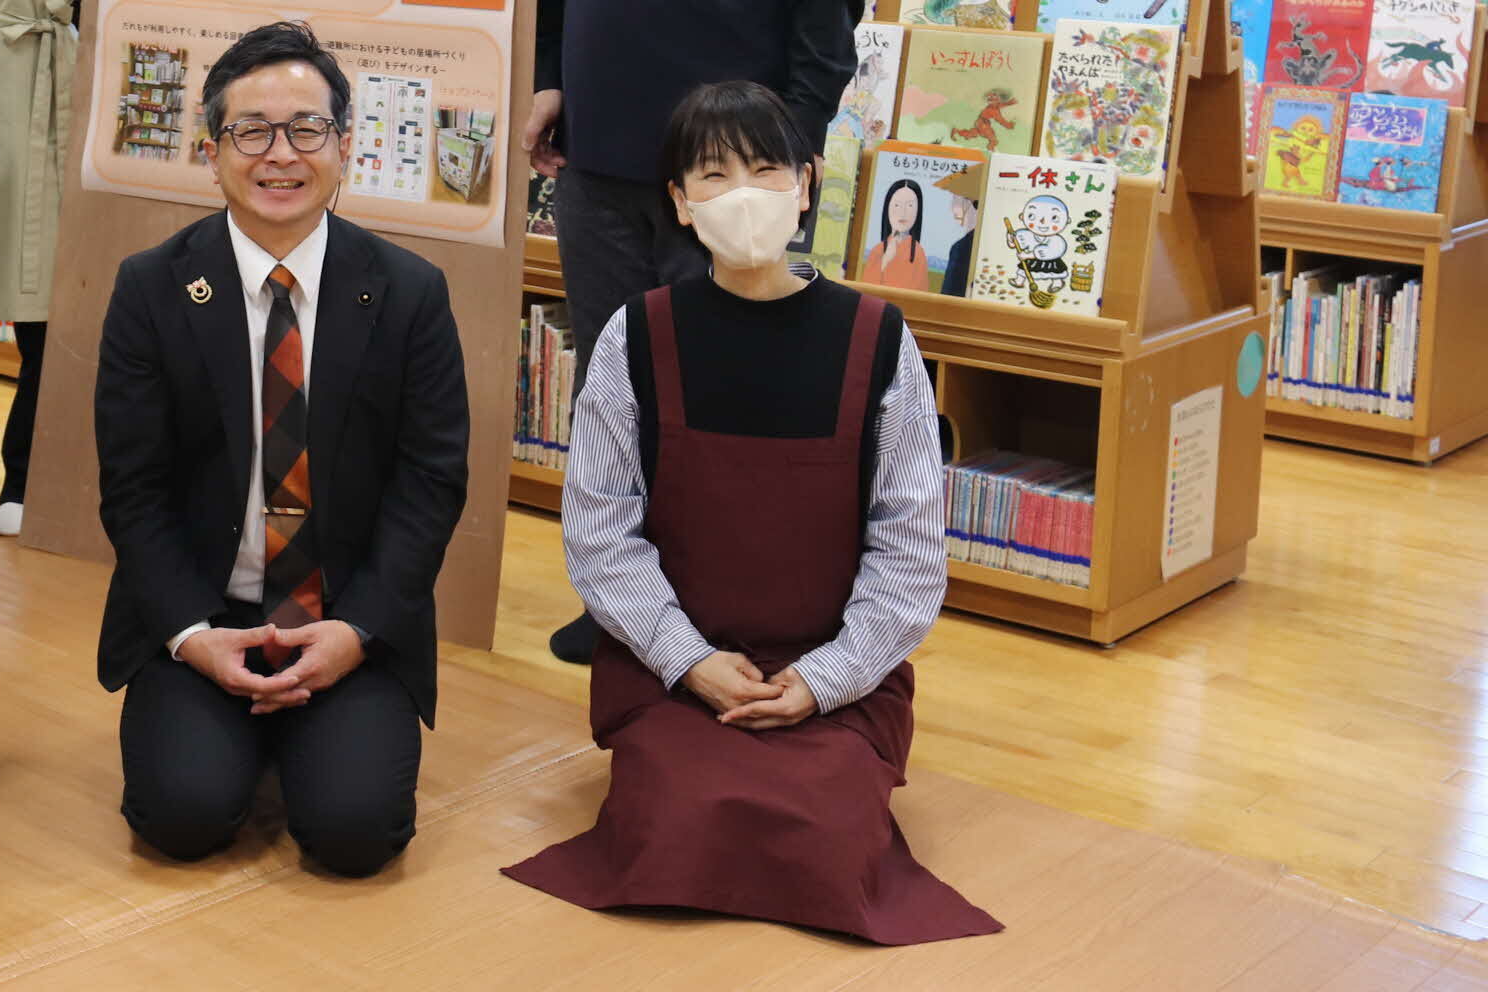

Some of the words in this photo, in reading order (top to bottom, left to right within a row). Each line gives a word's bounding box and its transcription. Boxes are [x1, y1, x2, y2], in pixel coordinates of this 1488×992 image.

[929, 50, 1014, 72] いっすんぼうし
[1058, 51, 1115, 66] たべられた
[892, 155, 969, 175] ももうりとのさま
[998, 166, 1106, 195] 一休さん
